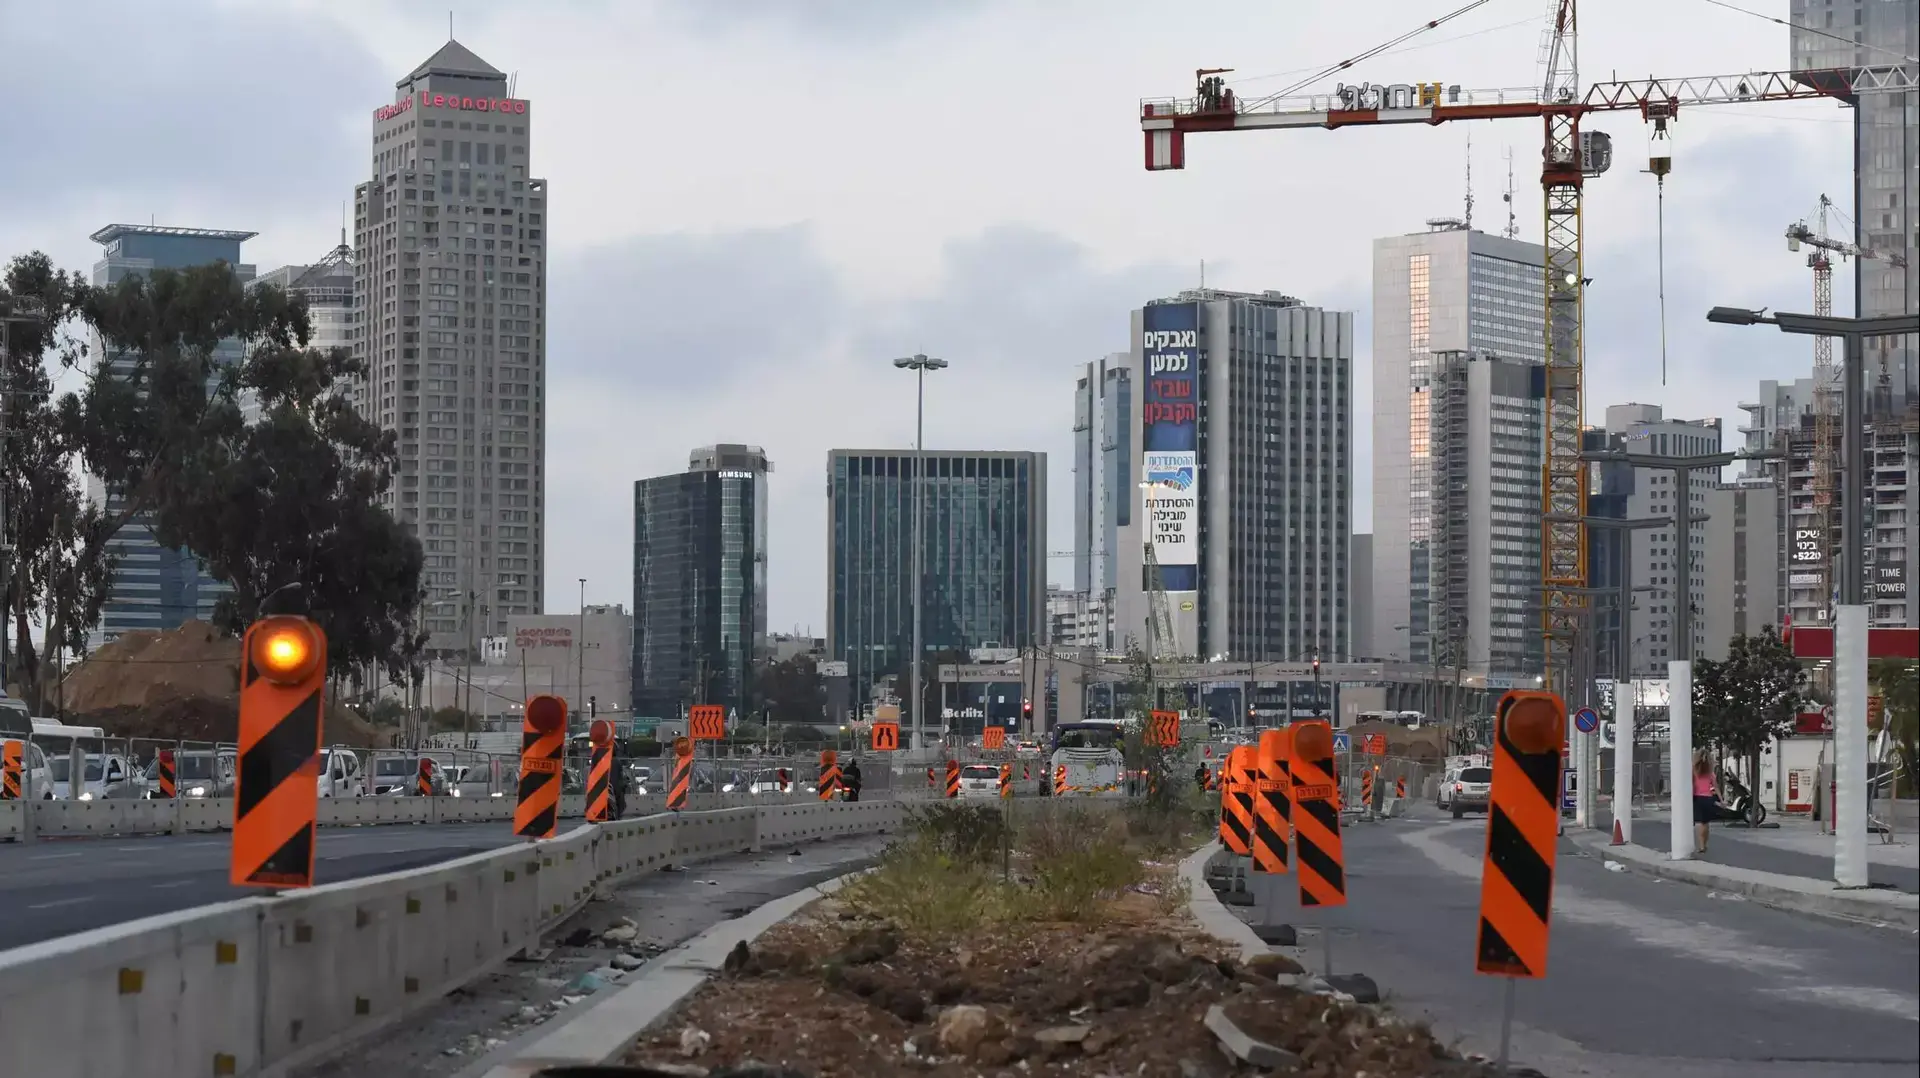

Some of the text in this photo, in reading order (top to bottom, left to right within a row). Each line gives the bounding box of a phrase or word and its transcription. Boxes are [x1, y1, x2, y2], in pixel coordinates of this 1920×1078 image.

[422, 91, 525, 114] Leonardo
[376, 96, 413, 121] Leonardo
[1144, 330, 1197, 352] נאבקים
[1150, 351, 1189, 376] למען
[1151, 379, 1191, 398] עובדי
[718, 471, 752, 479] SAMSUNG
[1153, 510, 1187, 521] מובילה
[1158, 522, 1182, 532] שינוי
[1155, 534, 1186, 543] חברתי
[1880, 568, 1901, 577] TIME
[1875, 583, 1906, 592] TOWER
[515, 626, 572, 637] Leonardo
